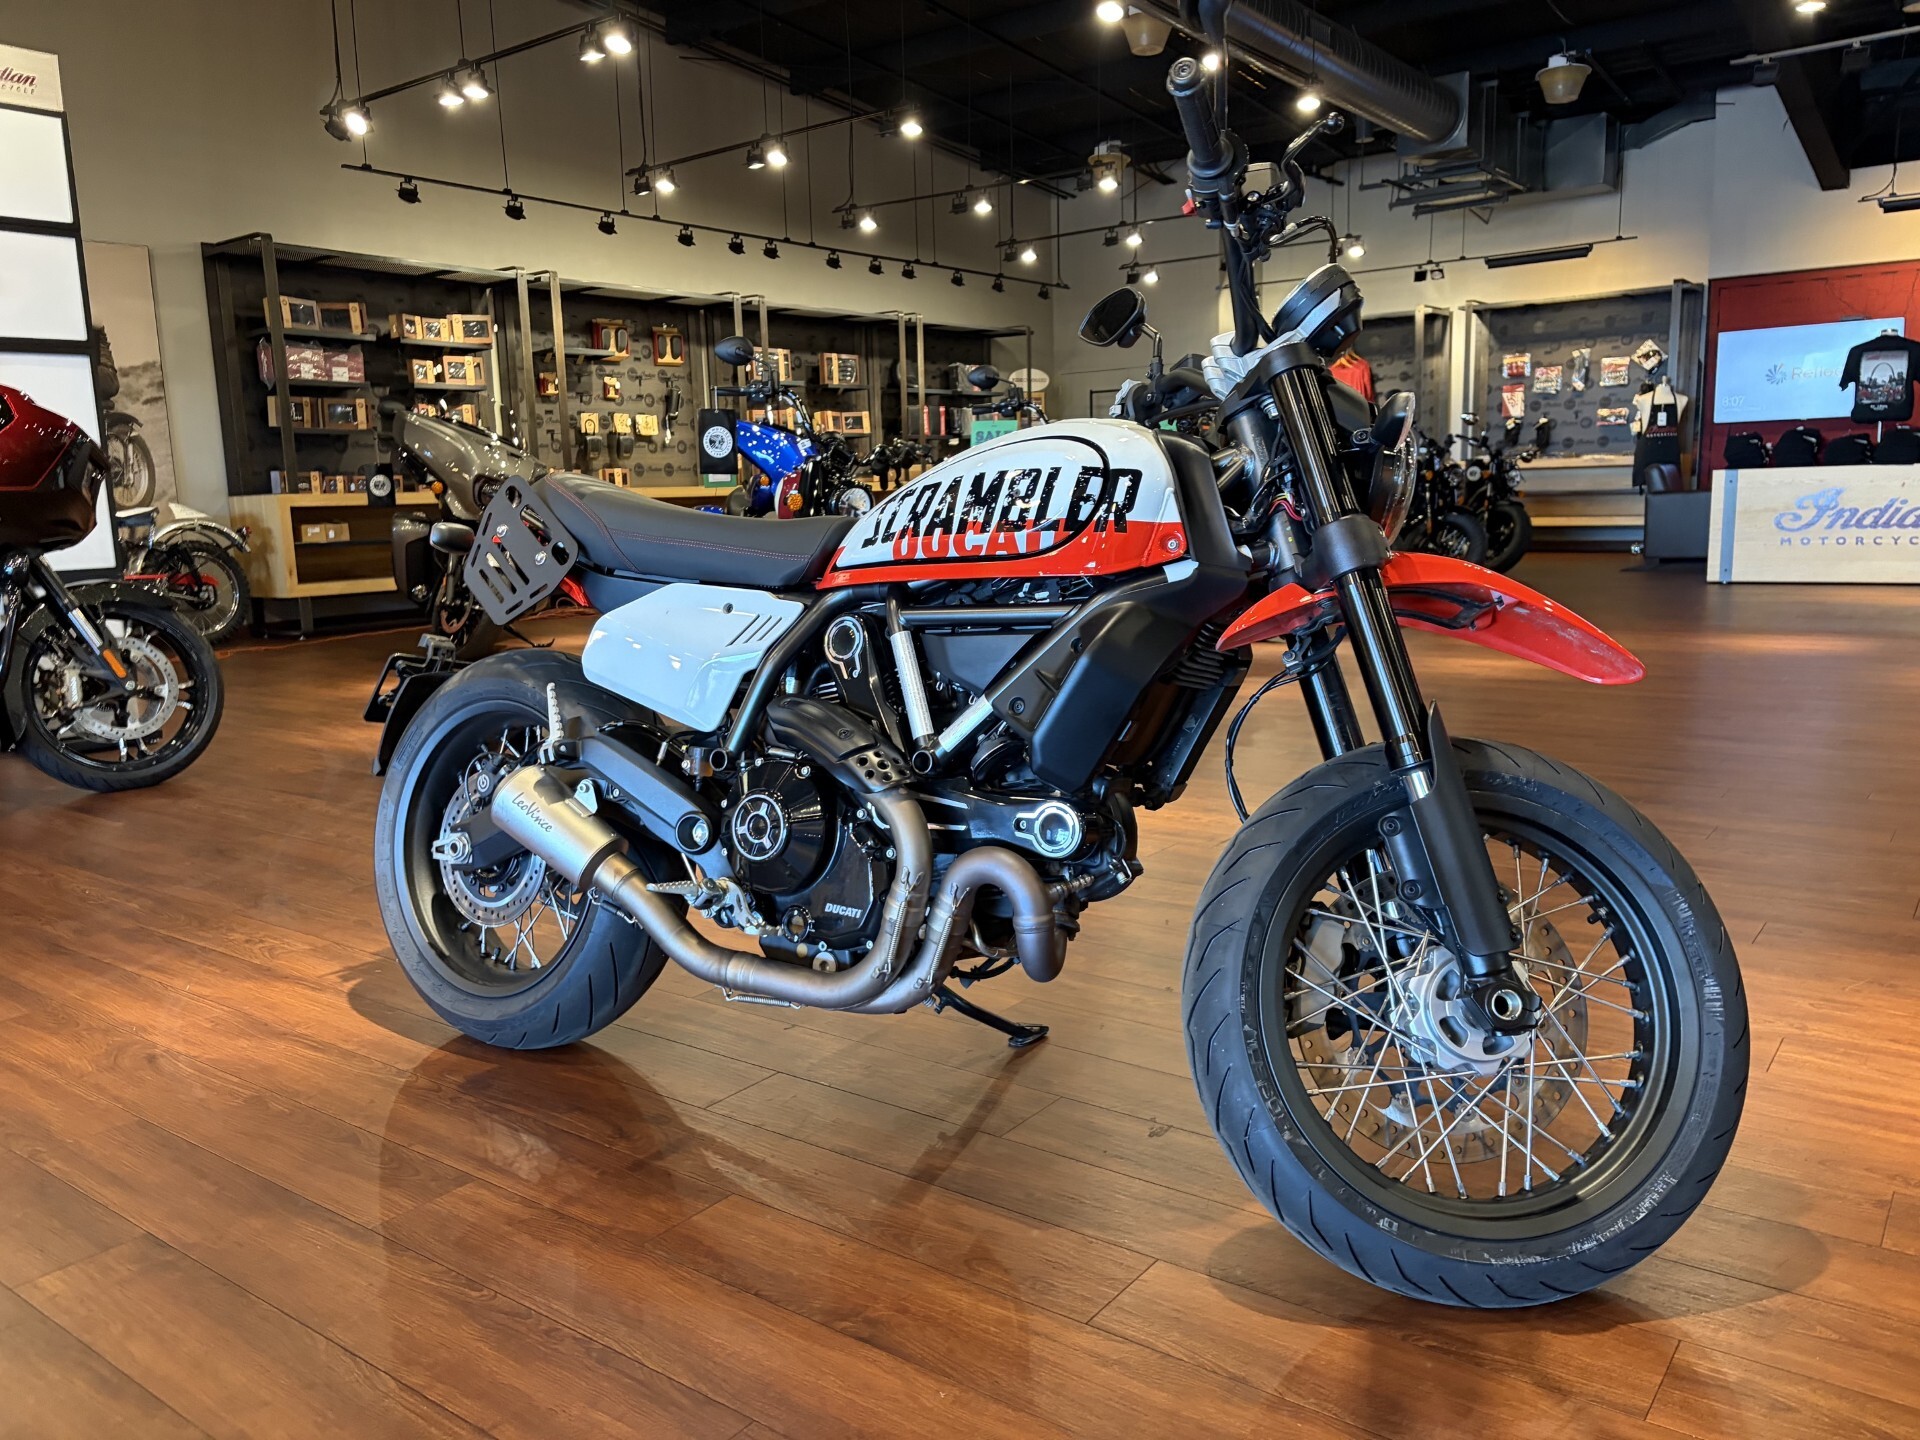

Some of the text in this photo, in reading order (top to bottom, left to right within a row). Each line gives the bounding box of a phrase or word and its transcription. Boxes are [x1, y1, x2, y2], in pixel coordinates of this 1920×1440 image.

[861, 466, 1142, 549] SCRAMBLER
[1774, 487, 1920, 532] India
[512, 791, 553, 833] LeoVince
[825, 903, 863, 919] DUCATI
